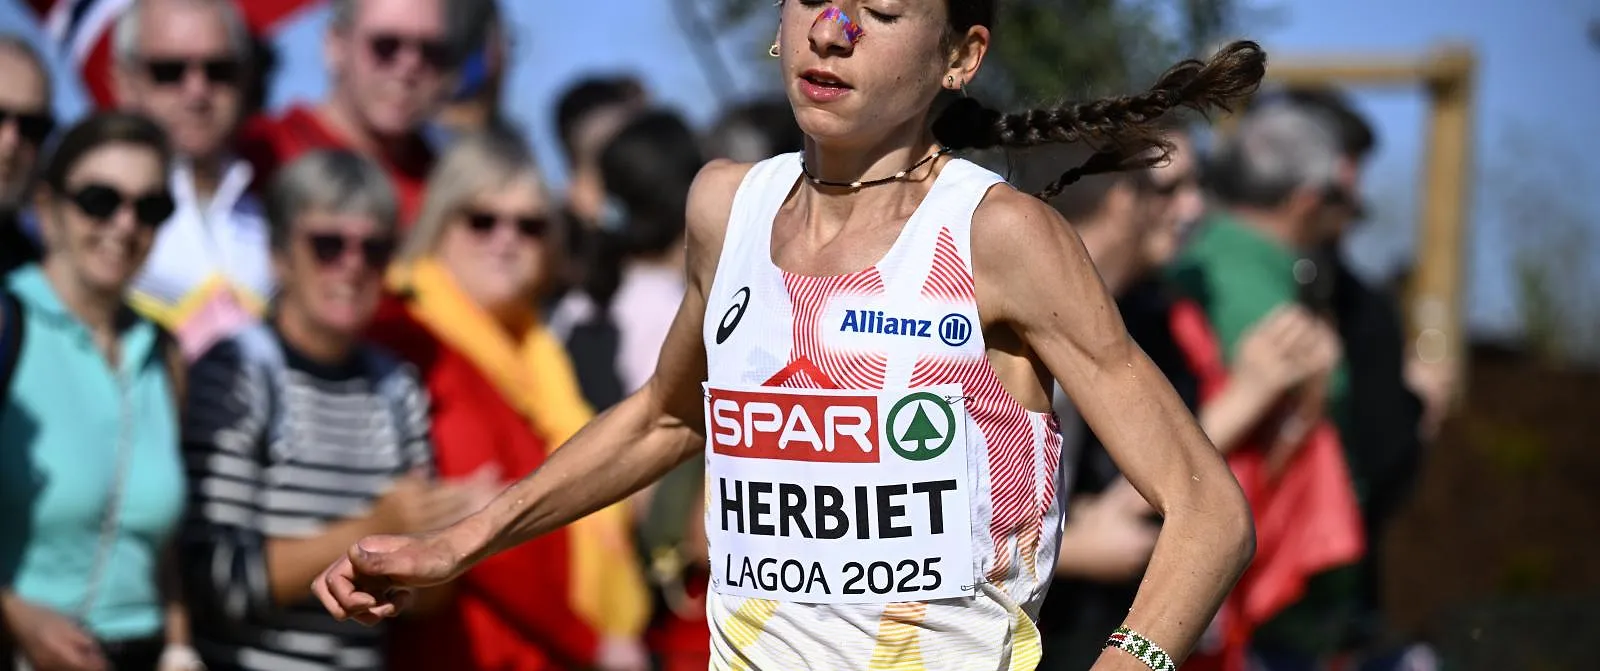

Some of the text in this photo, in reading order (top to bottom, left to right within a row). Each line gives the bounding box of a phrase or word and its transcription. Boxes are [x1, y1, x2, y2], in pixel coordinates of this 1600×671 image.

[840, 310, 932, 338] Allianz
[712, 399, 873, 453] SPAR
[719, 477, 958, 540] HERBIET
[725, 553, 942, 595] LAGOA 2025
